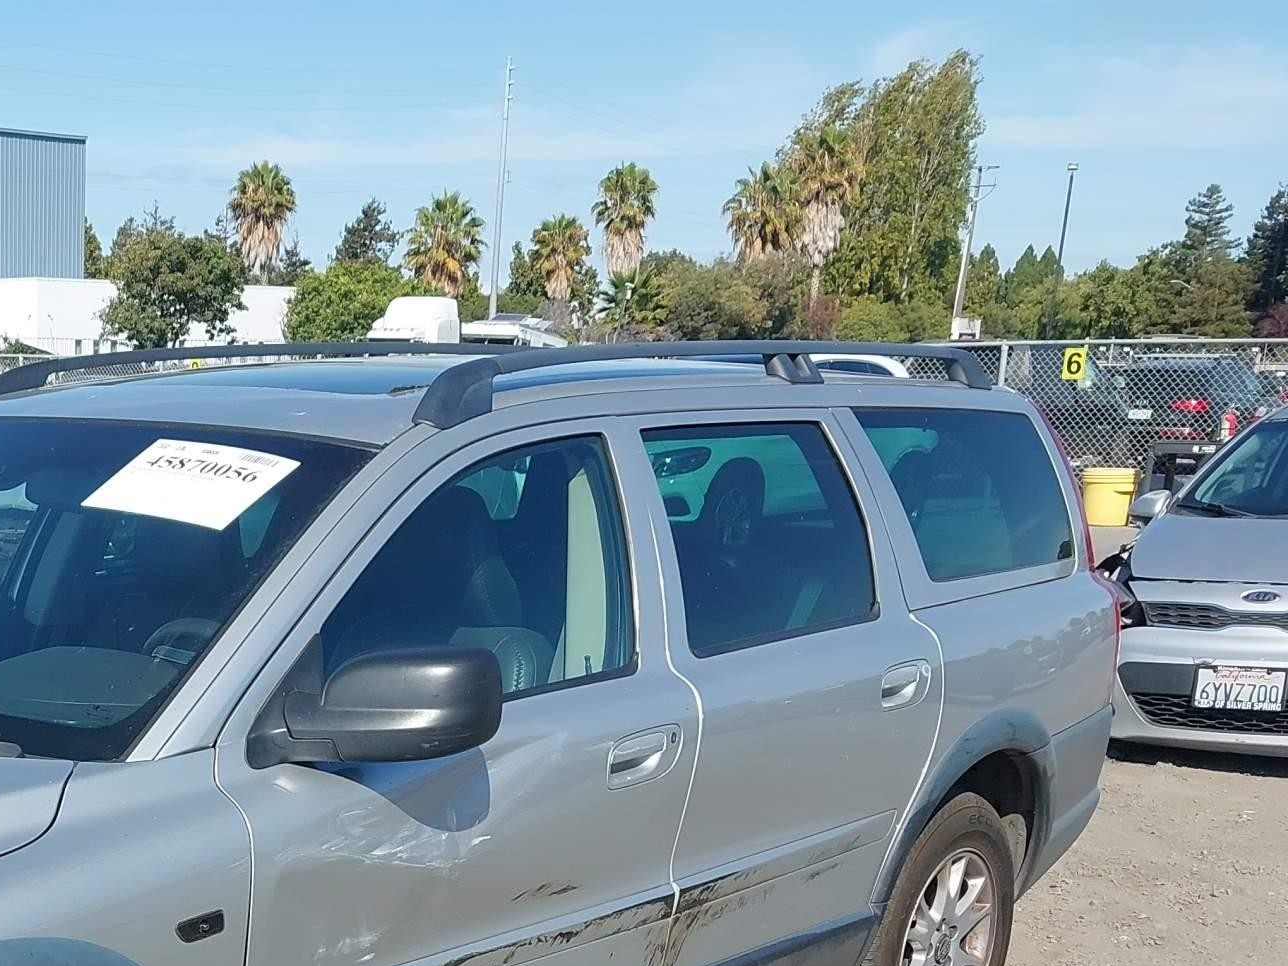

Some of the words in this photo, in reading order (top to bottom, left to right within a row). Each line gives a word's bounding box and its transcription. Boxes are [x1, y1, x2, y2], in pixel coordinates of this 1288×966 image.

[1066, 352, 1082, 374] 6
[146, 455, 258, 483] 45870056
[1200, 682, 1279, 703] 6YVZ700
[1226, 701, 1252, 709] SILVER
[1254, 702, 1281, 711] SPRING
